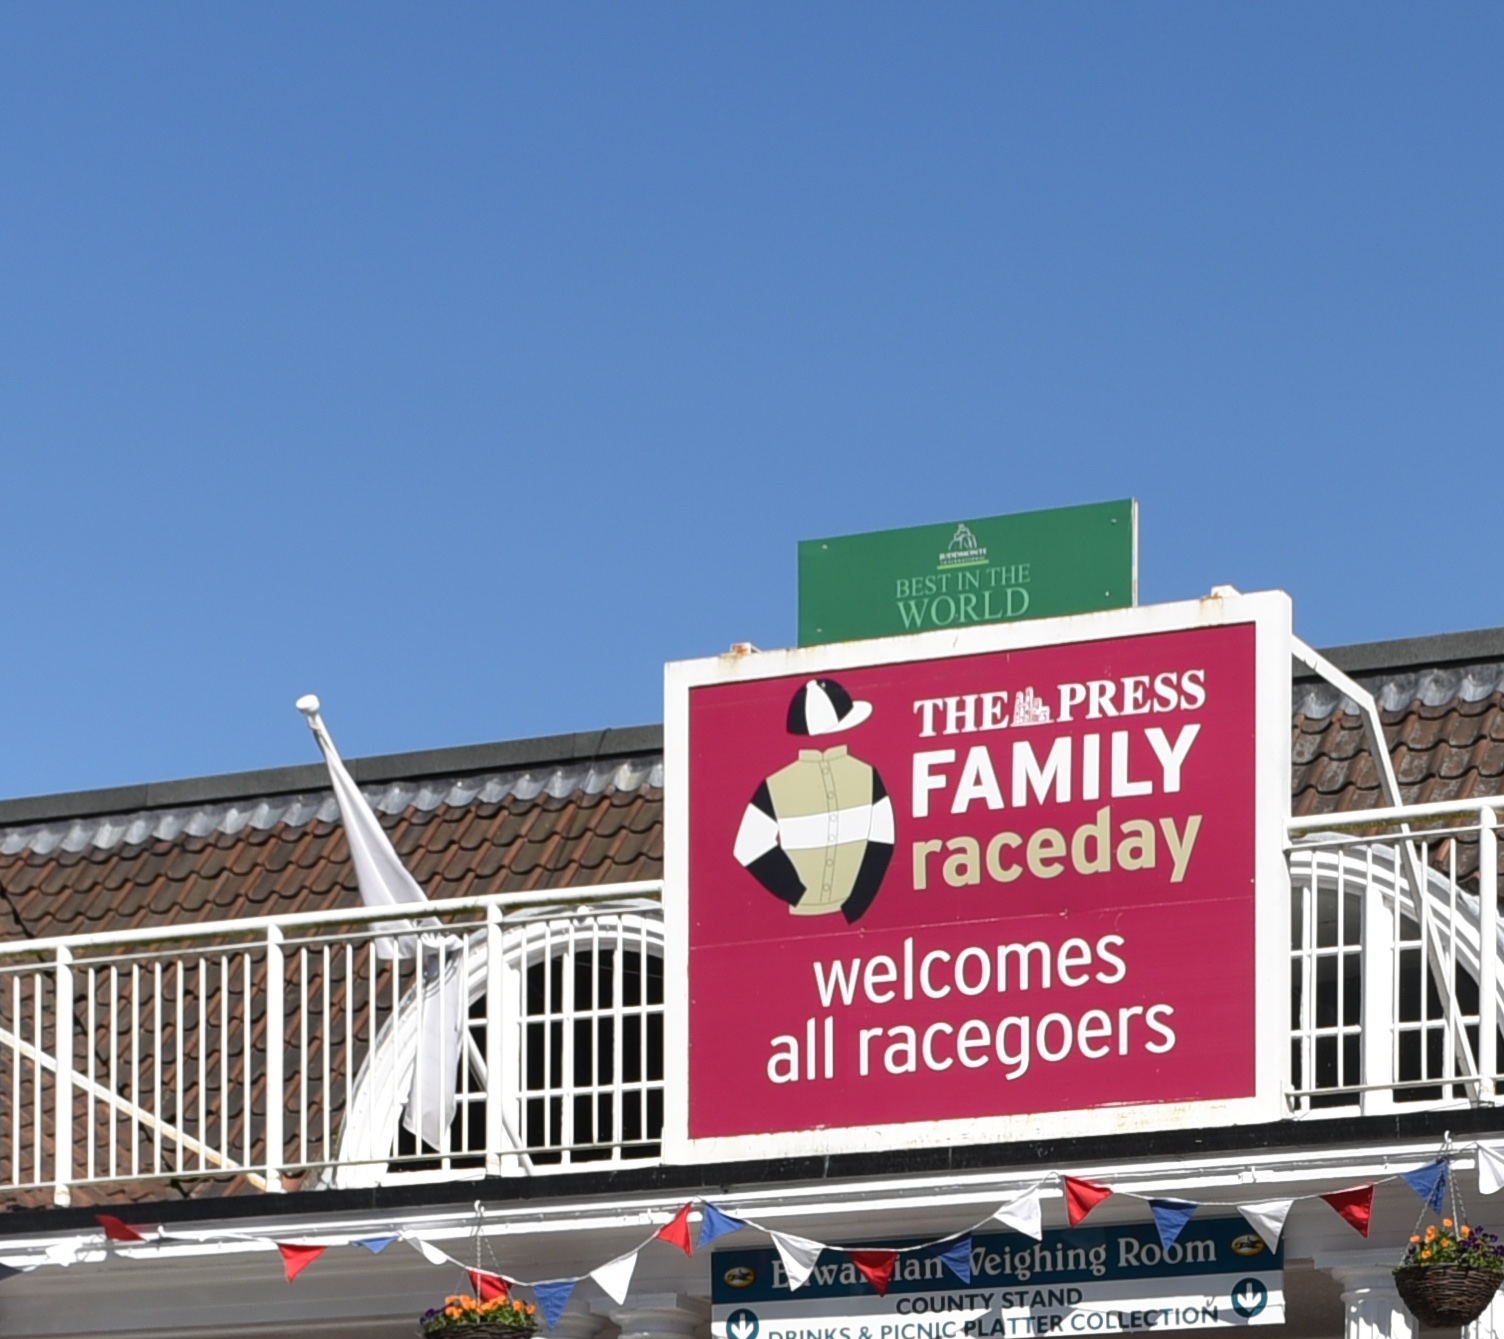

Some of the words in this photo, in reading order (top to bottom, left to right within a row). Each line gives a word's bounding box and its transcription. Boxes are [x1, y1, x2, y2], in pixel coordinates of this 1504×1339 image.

[896, 573, 951, 598] BEST
[956, 570, 980, 593] IN
[986, 564, 1031, 590] THE
[897, 586, 1030, 630] WORLD
[913, 690, 1009, 738] THE
[1057, 669, 1207, 722] PRESS
[911, 724, 1201, 818] FAMILY
[911, 806, 1202, 891] raceday
[813, 934, 1127, 1008] welcomes
[766, 1016, 835, 1083] all
[858, 1002, 1176, 1082] racegoers
[771, 1253, 944, 1289] Ewaian
[1117, 1237, 1217, 1268] Room
[896, 1293, 994, 1315] COUNTY
[1001, 1288, 1083, 1309] STAND
[963, 1315, 1063, 1338] PLATTER
[1071, 1305, 1219, 1331] COLLECTION
